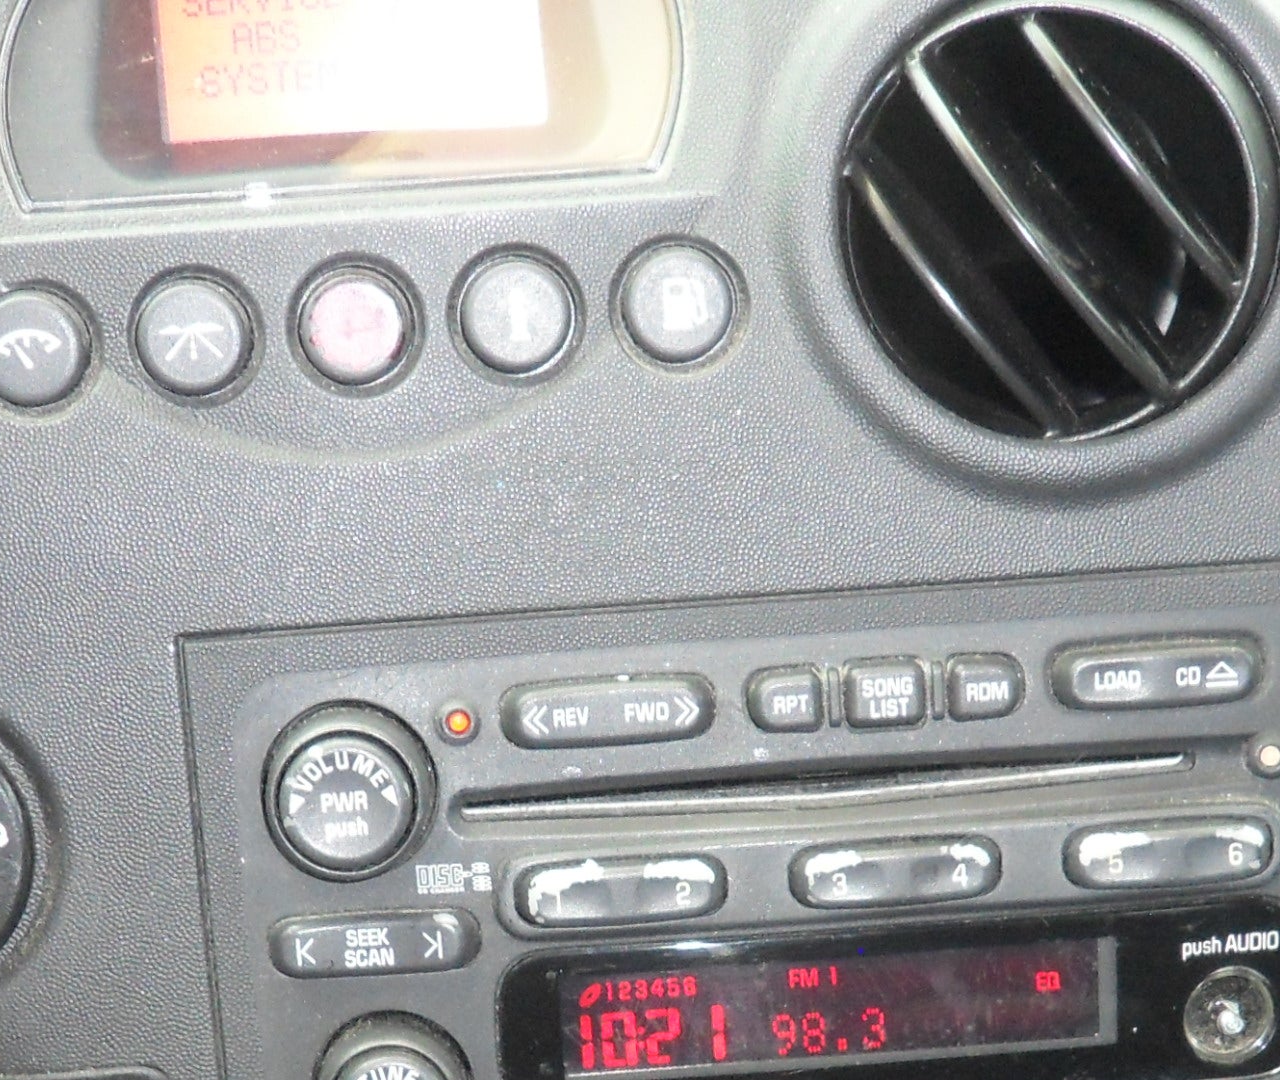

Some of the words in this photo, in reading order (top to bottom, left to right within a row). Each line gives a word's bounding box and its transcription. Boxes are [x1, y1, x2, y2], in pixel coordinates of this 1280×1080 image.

[232, 19, 302, 55] ABS
[862, 676, 914, 699] SONG
[1094, 670, 1141, 691] LOAD
[1175, 666, 1201, 688] CD
[966, 681, 1009, 703] RDM
[624, 700, 669, 723] FWD
[773, 694, 809, 716] RPT
[870, 699, 910, 720] LIST
[552, 708, 589, 729] REV
[294, 748, 391, 793] VOLUME
[320, 790, 369, 814] PWR
[324, 816, 370, 844] push
[1107, 851, 1125, 877] 5
[1227, 841, 1245, 866] 6
[414, 863, 465, 888] DISC
[831, 872, 848, 897] 3
[951, 862, 969, 888] 4
[675, 881, 692, 907] 2
[345, 927, 390, 948] SEEK
[1181, 936, 1222, 962] push
[1224, 931, 1279, 953] AUDIO
[344, 947, 395, 969] SCAN
[788, 968, 819, 989] FM
[829, 966, 839, 987] 1
[1035, 971, 1062, 992] EQ
[772, 1007, 887, 1057] 98.3
